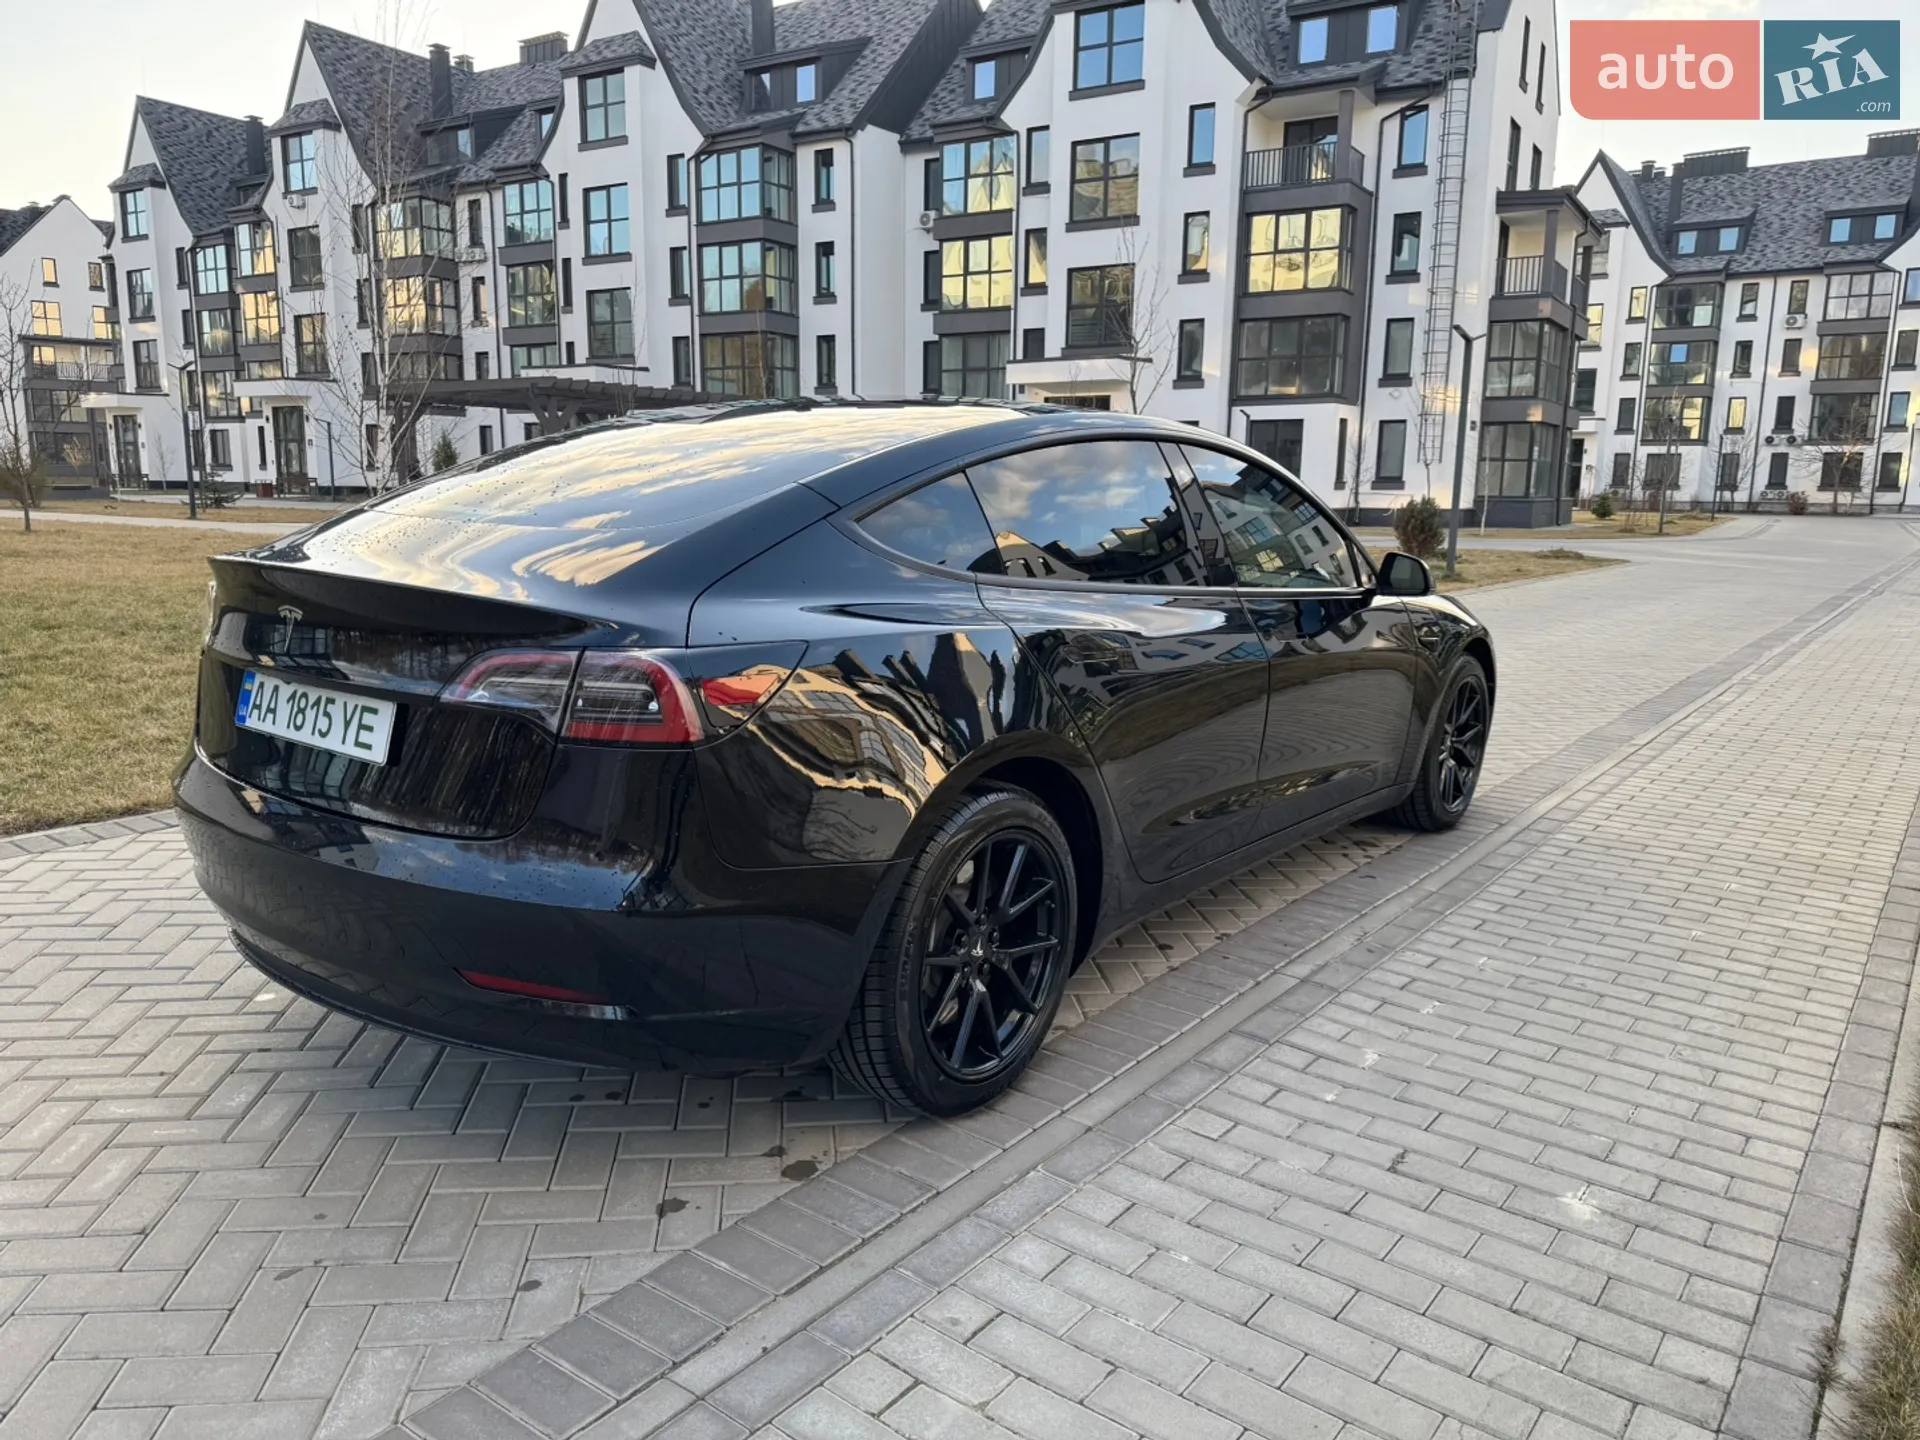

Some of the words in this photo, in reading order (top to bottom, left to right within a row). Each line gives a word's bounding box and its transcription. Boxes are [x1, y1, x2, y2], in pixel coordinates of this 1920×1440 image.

[249, 681, 279, 725] AA
[286, 689, 335, 738] 1815
[341, 701, 378, 750] YE
